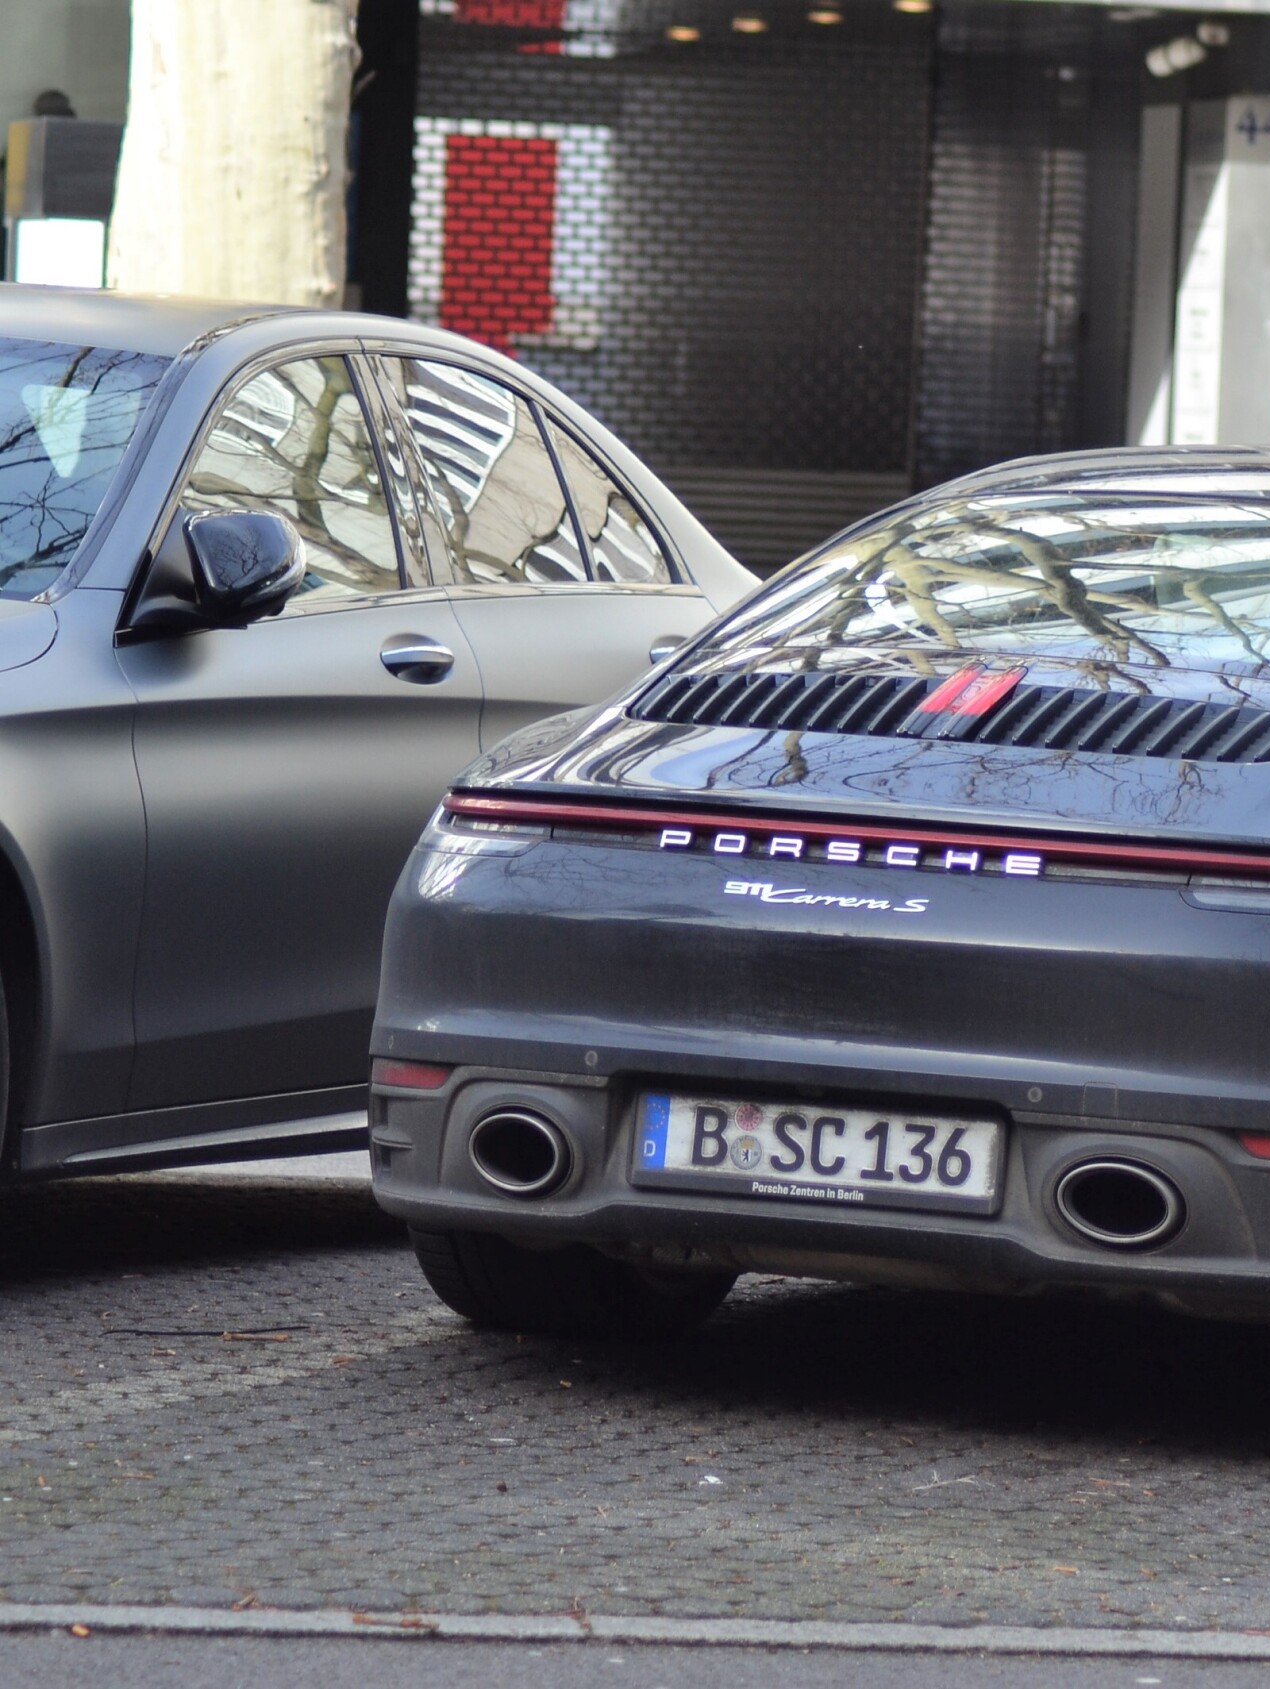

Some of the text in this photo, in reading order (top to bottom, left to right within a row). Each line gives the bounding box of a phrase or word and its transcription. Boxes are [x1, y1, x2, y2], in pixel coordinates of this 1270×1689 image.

[659, 829, 1041, 876] PORSCHE
[761, 888, 892, 912] Carrera
[893, 898, 930, 913] S
[643, 1139, 656, 1158] D
[691, 1106, 729, 1166] B
[859, 1121, 972, 1187] 136
[752, 1181, 864, 1201] Porsche Zentren in Berlin
